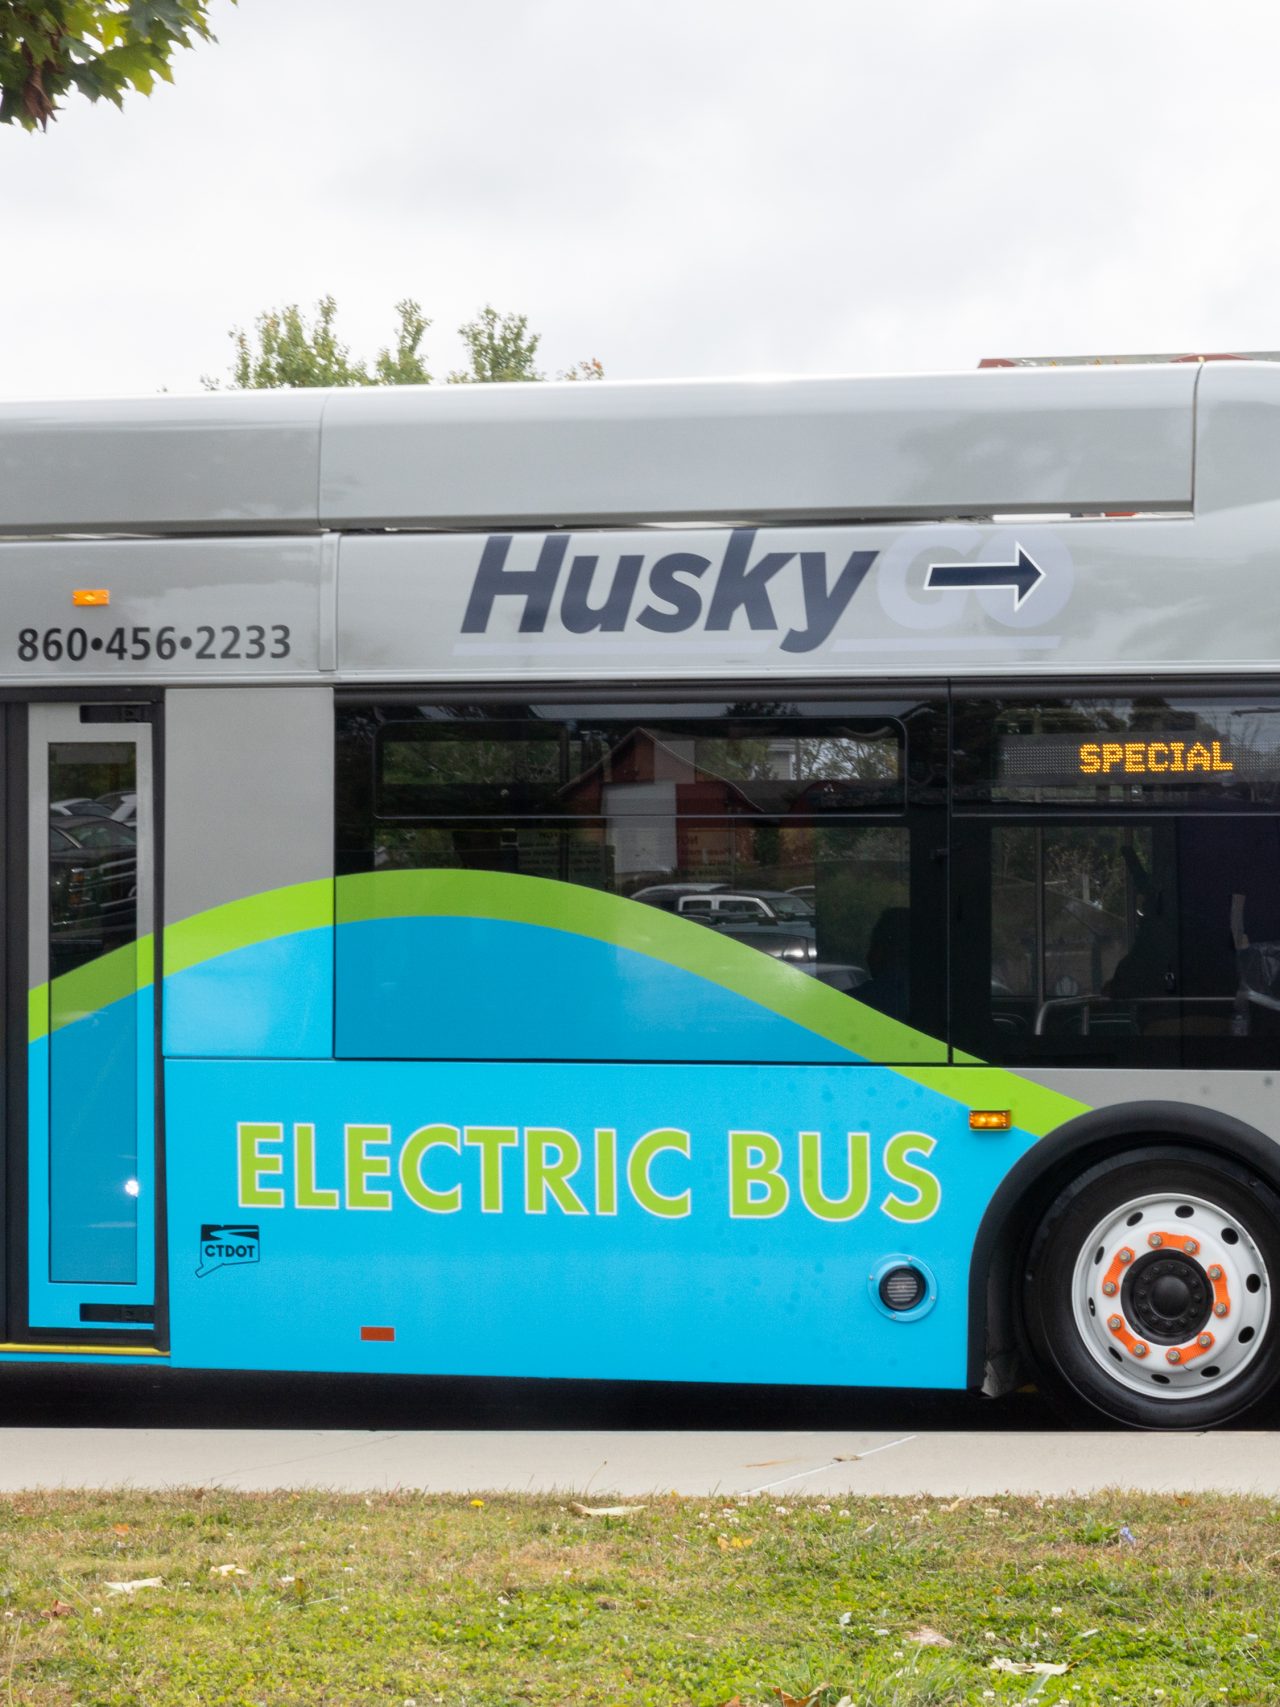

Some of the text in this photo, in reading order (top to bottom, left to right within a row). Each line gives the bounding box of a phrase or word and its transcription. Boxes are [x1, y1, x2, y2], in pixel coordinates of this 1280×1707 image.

[1078, 740, 1235, 774] SPECIAL
[236, 1121, 943, 1224] ELECTRIC BUS
[204, 1244, 256, 1258] CTDOT
